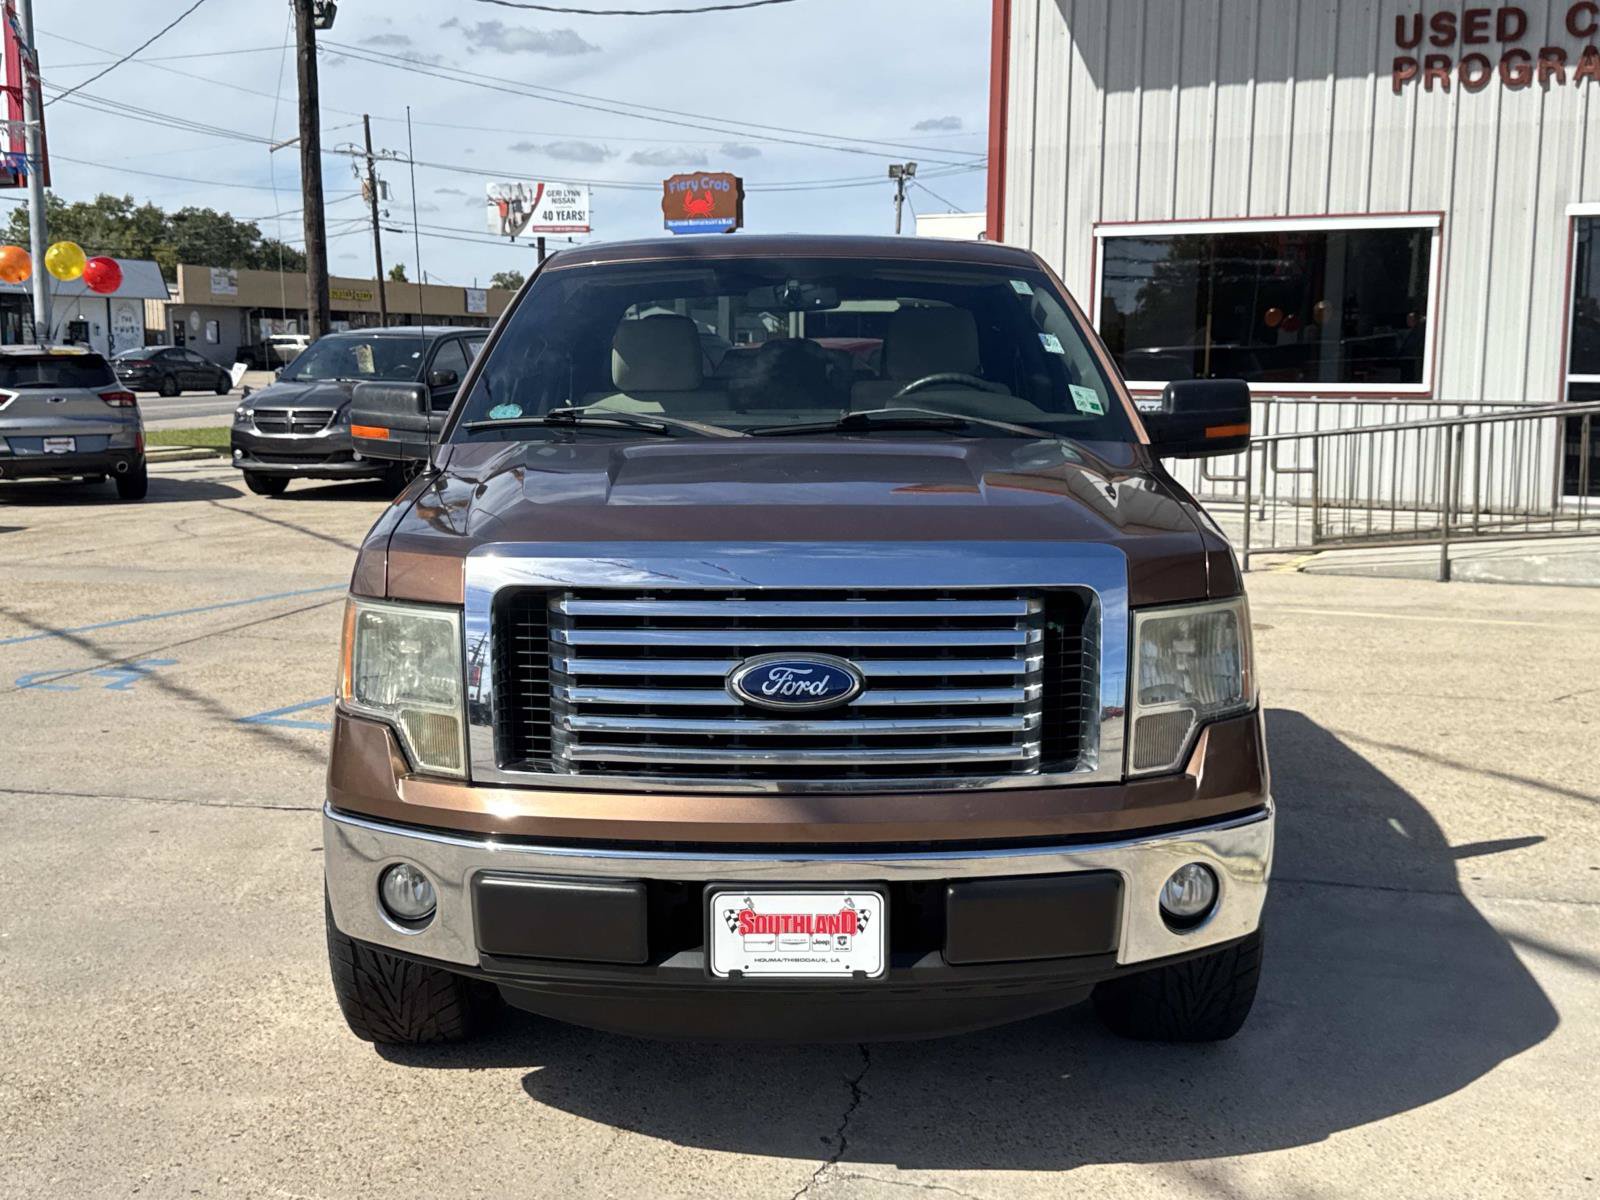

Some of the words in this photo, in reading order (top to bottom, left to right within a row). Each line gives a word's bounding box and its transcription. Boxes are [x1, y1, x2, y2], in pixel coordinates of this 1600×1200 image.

[1396, 6, 1528, 49] USED
[1392, 45, 1600, 93] PROGRA
[563, 189, 581, 197] LYNN
[669, 179, 699, 193] Fiery
[700, 176, 730, 192] Crab
[542, 210, 553, 221] 40
[556, 210, 586, 221] YEARS!
[761, 667, 830, 696] Ford
[738, 909, 858, 936] SOUTHLAND
